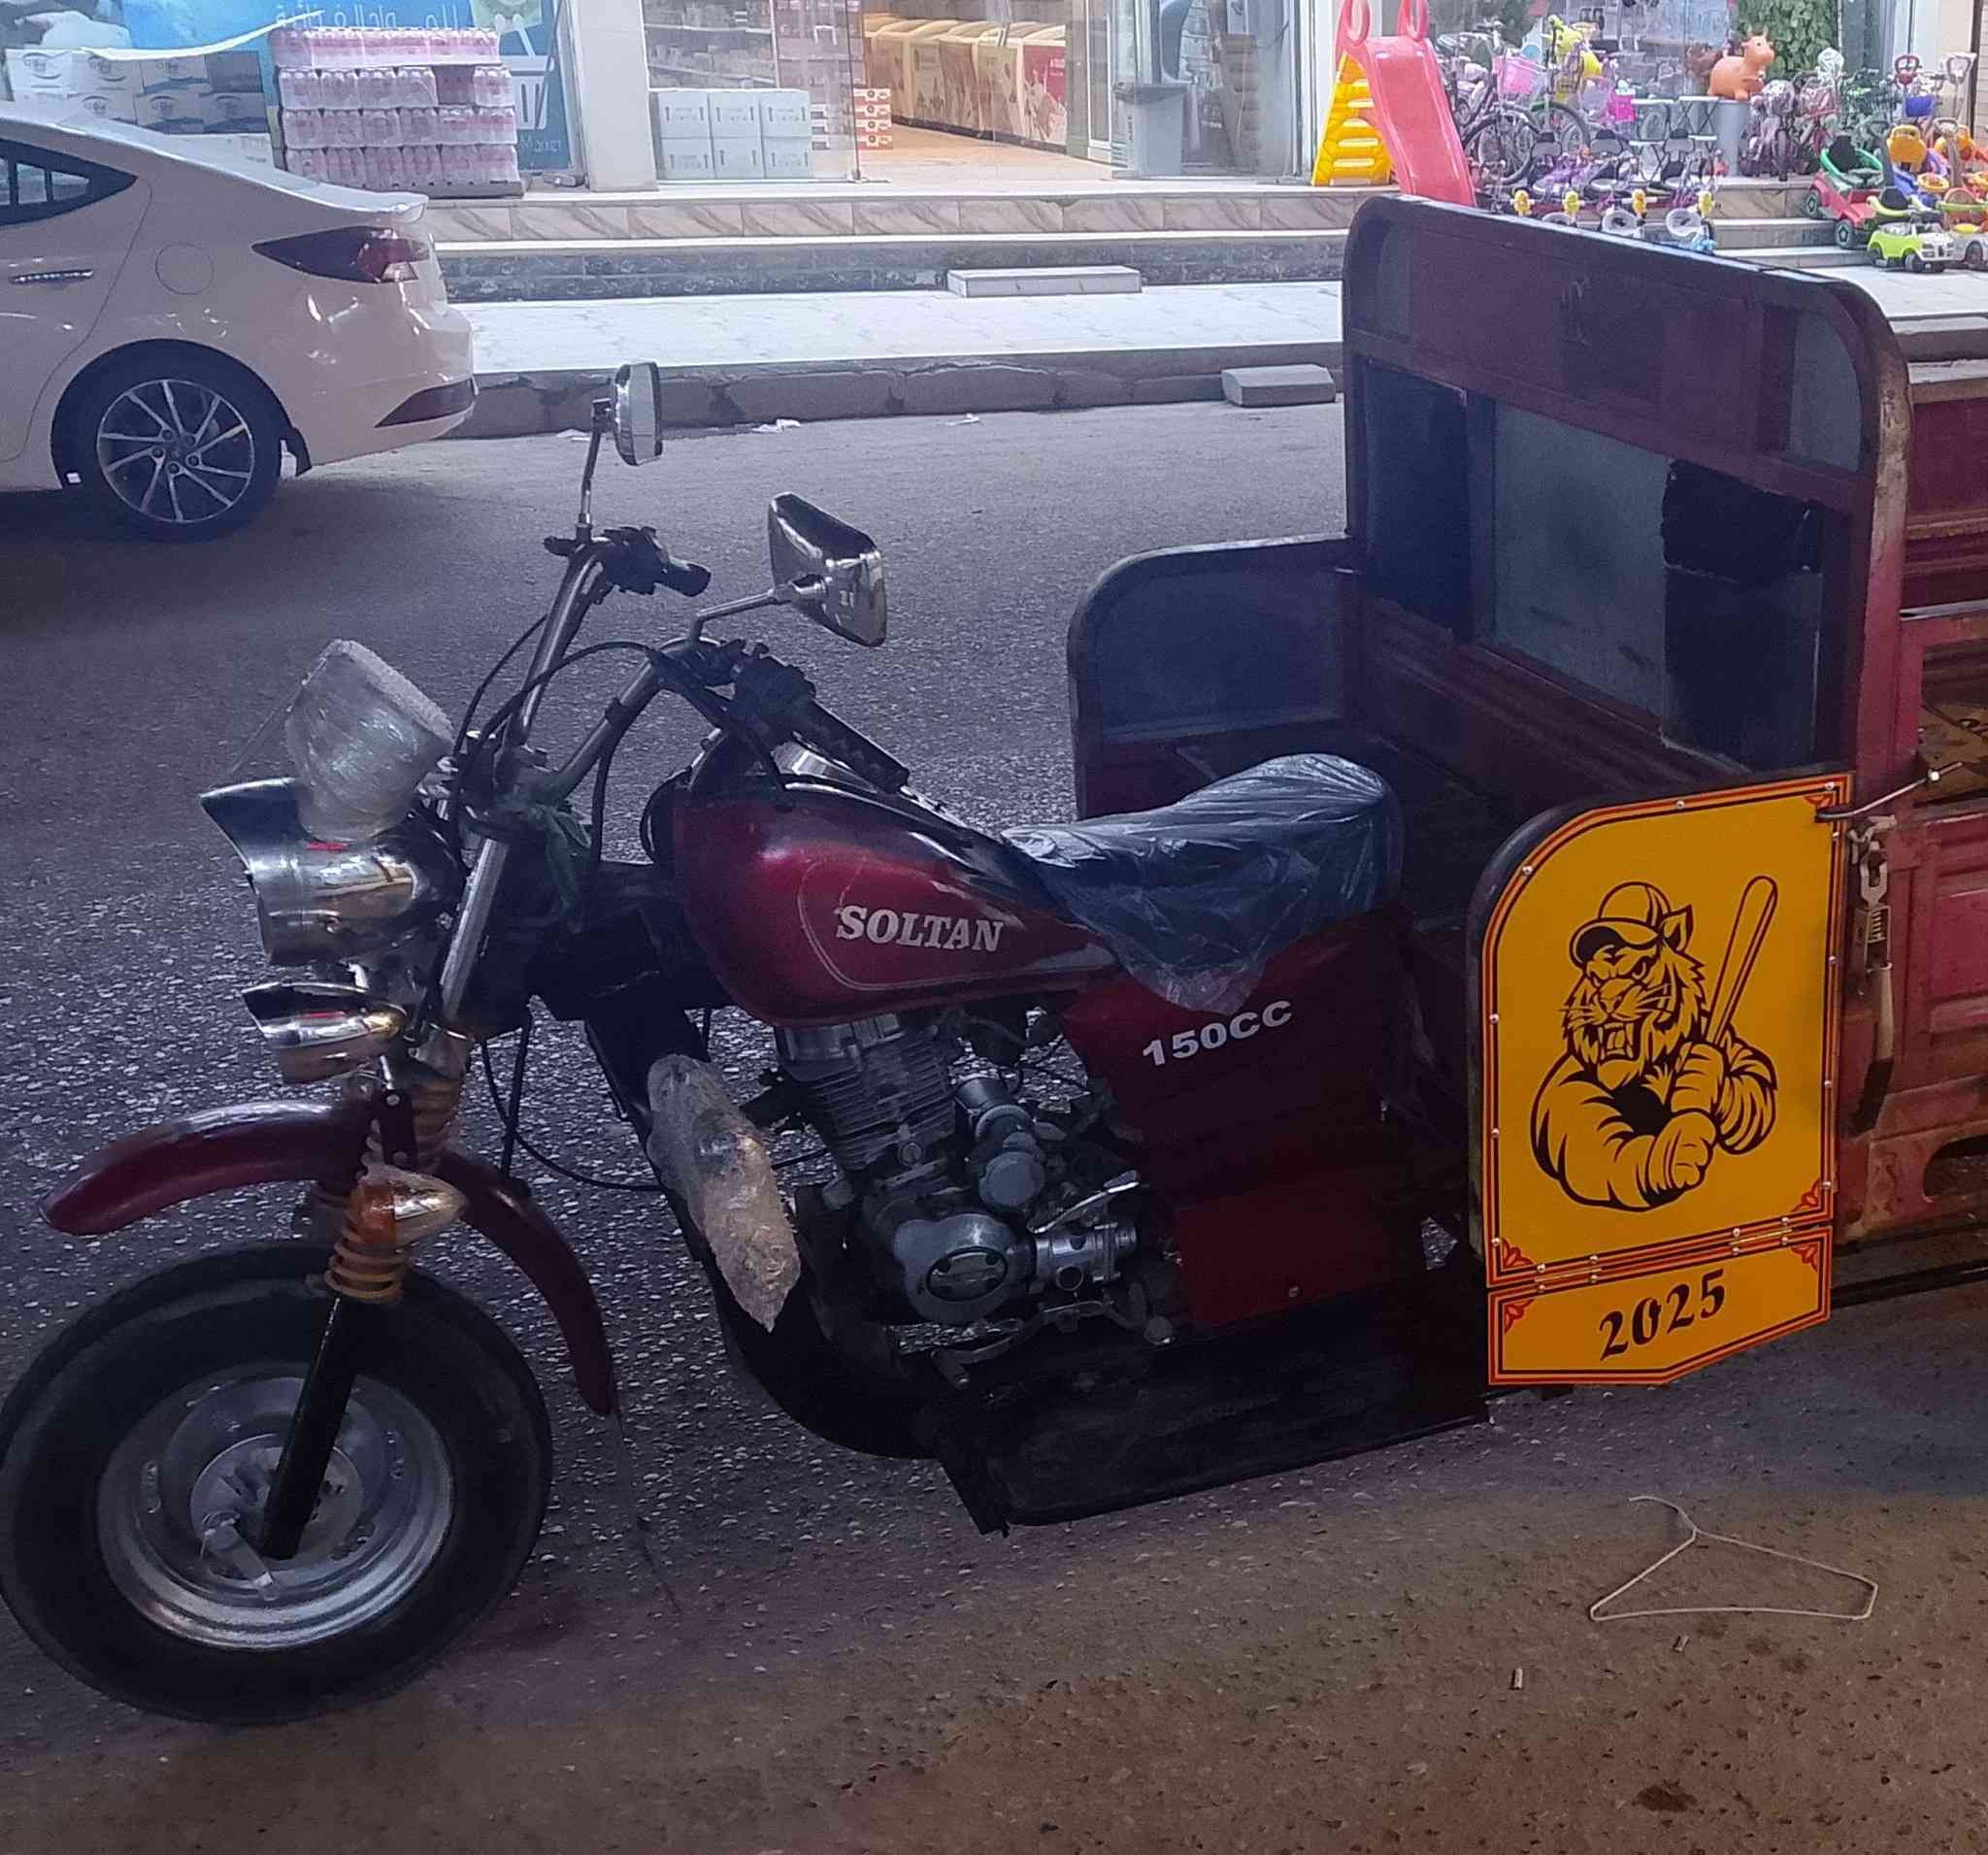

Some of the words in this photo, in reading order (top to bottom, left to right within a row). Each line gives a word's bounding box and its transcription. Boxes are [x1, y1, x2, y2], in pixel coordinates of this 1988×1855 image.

[835, 905, 1004, 951] SOLTAN
[1142, 1001, 1292, 1067] 150CC
[1599, 1268, 1725, 1361] 2025
